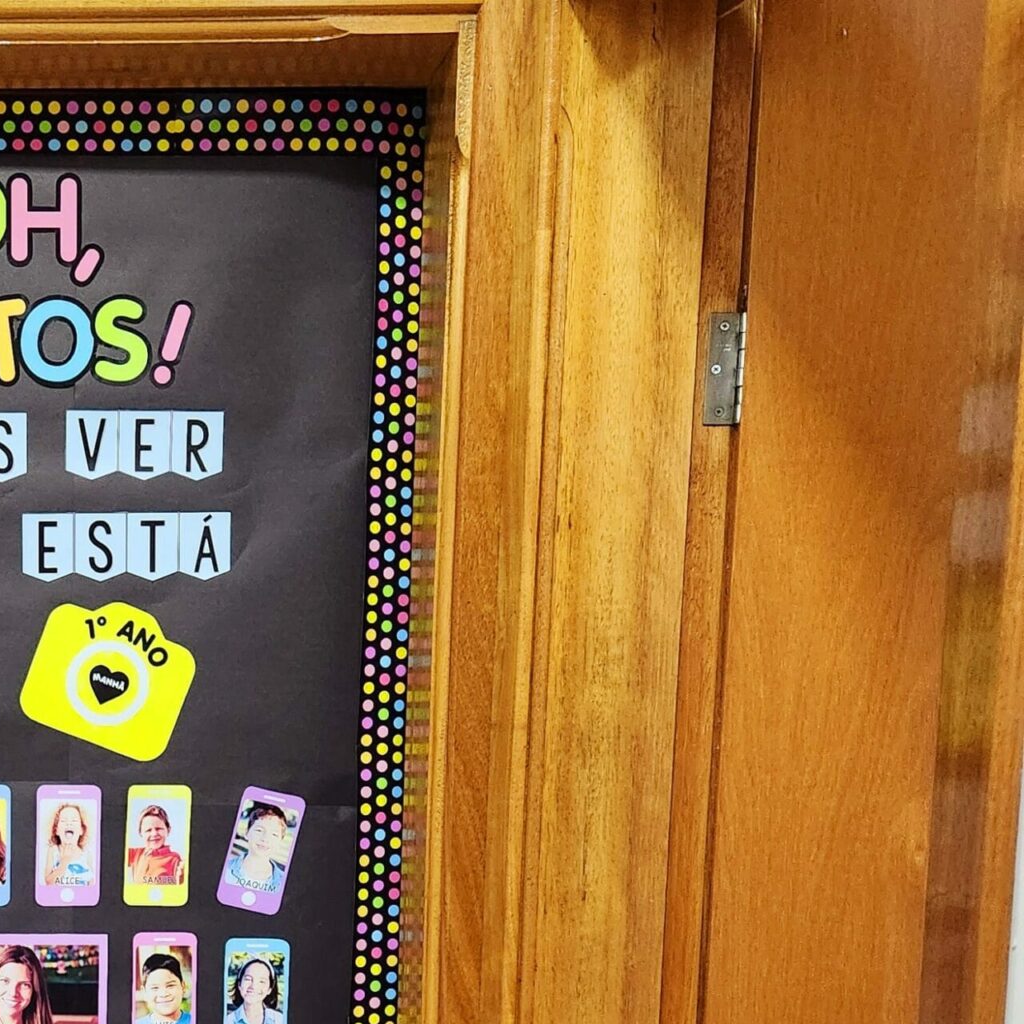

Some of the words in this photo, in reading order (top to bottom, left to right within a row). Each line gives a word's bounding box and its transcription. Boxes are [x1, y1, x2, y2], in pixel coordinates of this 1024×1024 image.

[78, 418, 211, 473] VER
[38, 514, 220, 575] ESTÁ
[116, 620, 169, 667] ANO
[91, 672, 125, 691] MANHÃ
[55, 876, 81, 885] ALICE
